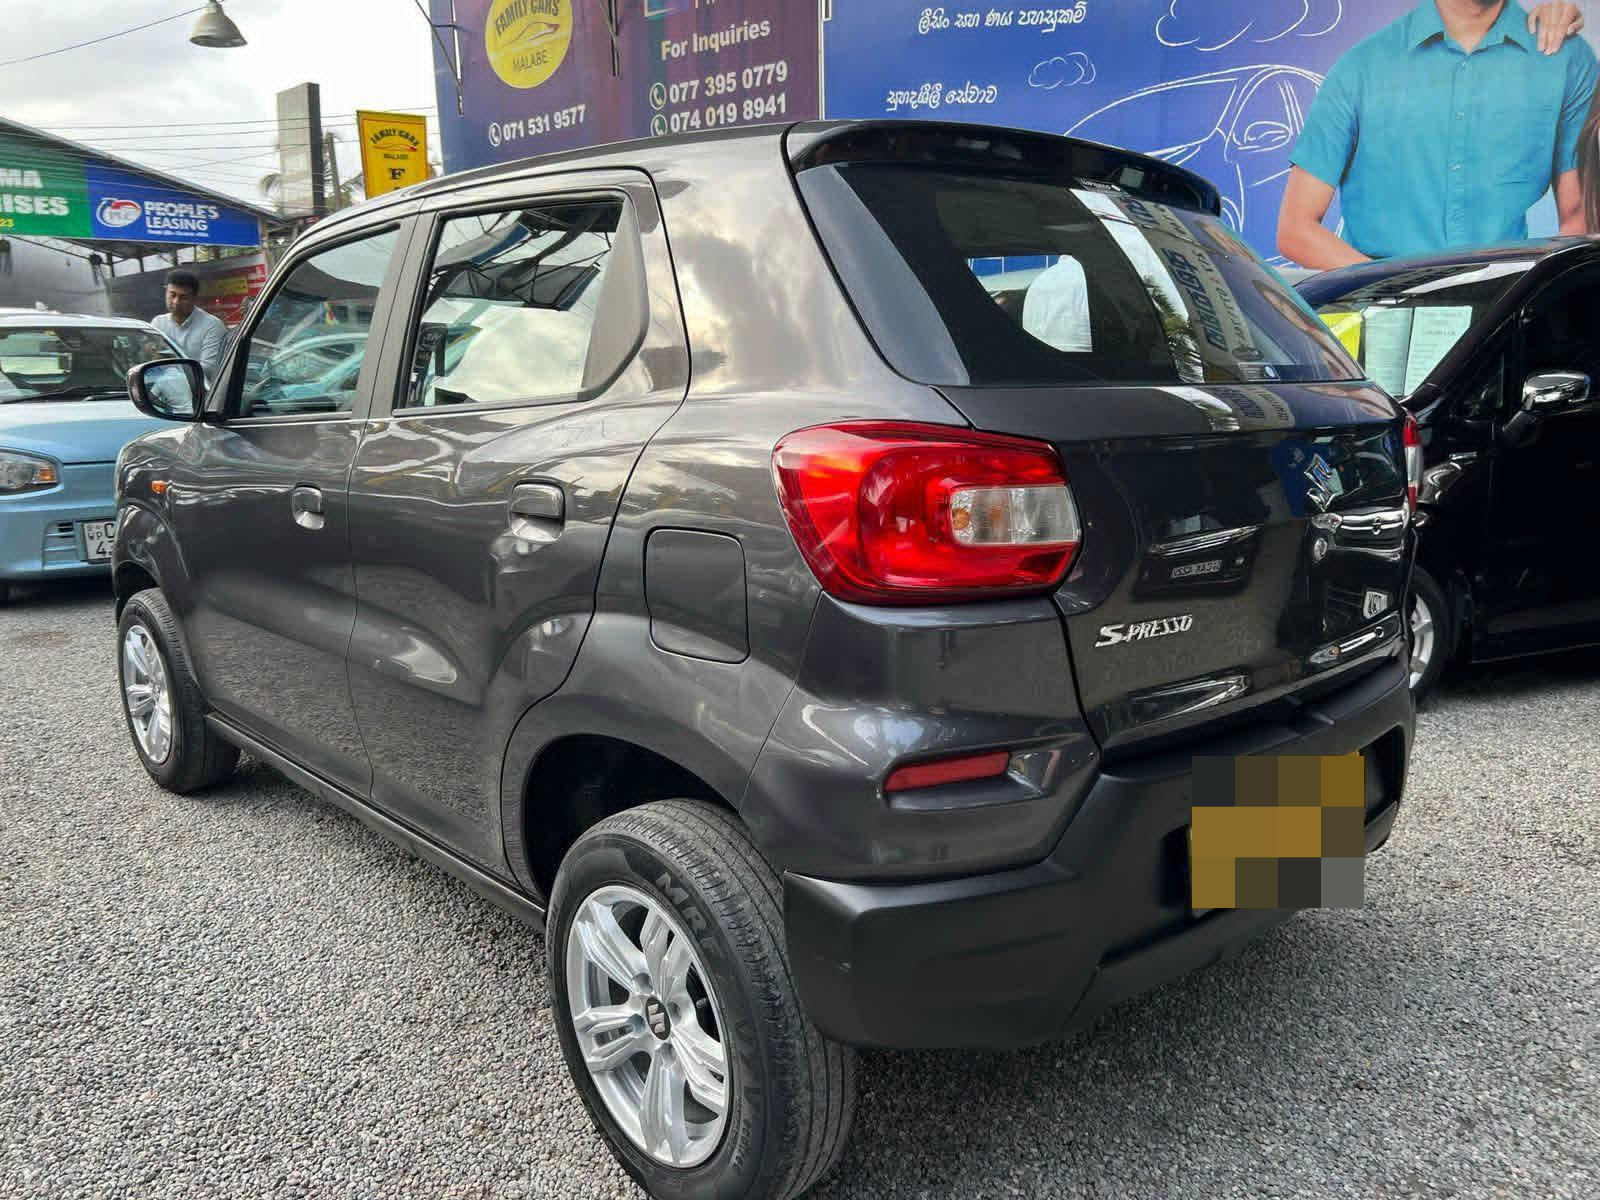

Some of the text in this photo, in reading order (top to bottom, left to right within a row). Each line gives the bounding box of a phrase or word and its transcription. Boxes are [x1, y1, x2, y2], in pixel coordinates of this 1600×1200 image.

[954, 13, 980, 28] සහ
[984, 9, 1013, 27] ණය
[1018, 1, 1087, 33] පහසුකම්
[661, 20, 770, 60] For Inquiries
[669, 61, 787, 103] 077 395 0779
[945, 80, 998, 104] සේවාව
[503, 104, 586, 141] 071 531 9577
[670, 92, 786, 133] 074 019 8941
[0, 194, 69, 215] ISES
[146, 216, 208, 231] LEASING
